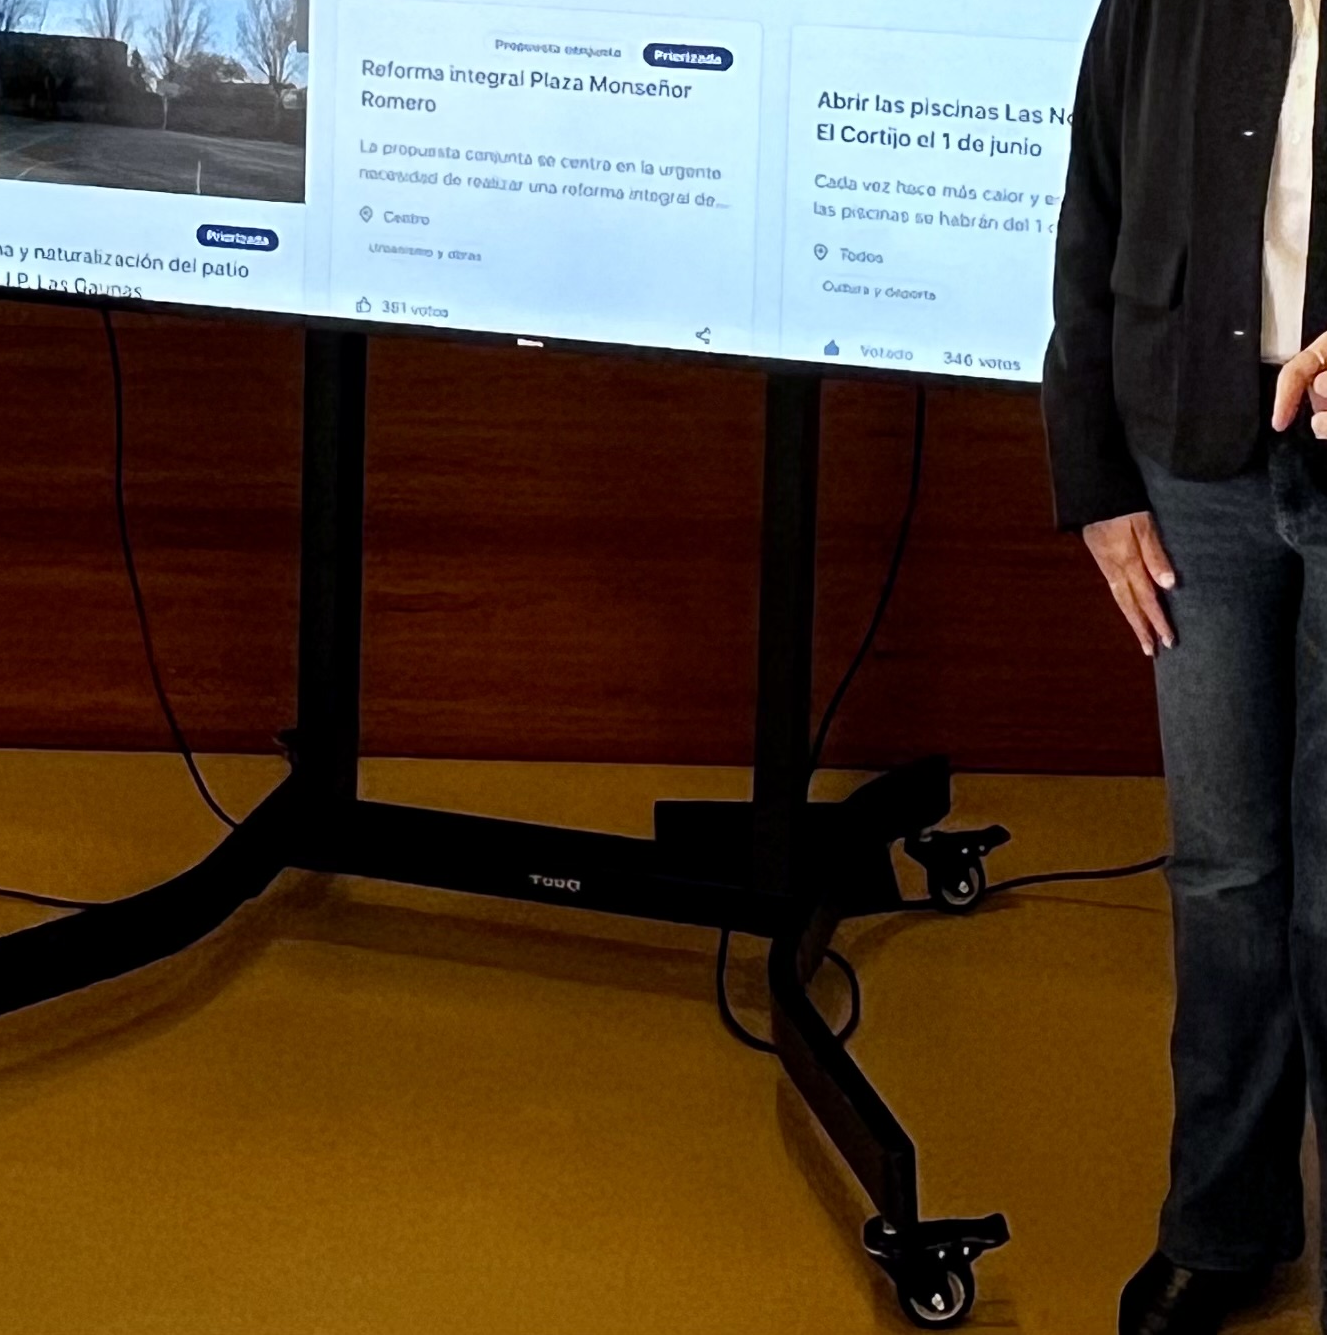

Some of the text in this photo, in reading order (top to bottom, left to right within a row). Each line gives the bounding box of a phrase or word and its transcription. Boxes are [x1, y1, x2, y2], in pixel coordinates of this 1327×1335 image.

[361, 59, 693, 100] Reforma integral Plaza Monseñor
[361, 90, 438, 113] Romero
[818, 91, 1073, 127] Abrir las piscinas Las No
[817, 124, 1042, 157] El Cortijo el 1 de junio
[814, 174, 858, 191] Cada
[862, 180, 891, 194] vez
[896, 181, 937, 197] hace
[942, 184, 977, 200] más
[982, 189, 1024, 204] calor
[383, 210, 431, 226] Centro
[813, 201, 836, 217] las
[841, 206, 909, 222] piscinas
[939, 212, 999, 230] habrán
[1003, 218, 1029, 232] del
[1034, 219, 1042, 233] 1
[19, 247, 29, 262] y
[34, 245, 164, 271] naturalización
[168, 251, 198, 273] del
[201, 257, 250, 279] patio
[839, 247, 884, 264] Todos
[411, 306, 449, 318] votos
[860, 344, 914, 361] Votado
[978, 357, 1021, 372] votos
